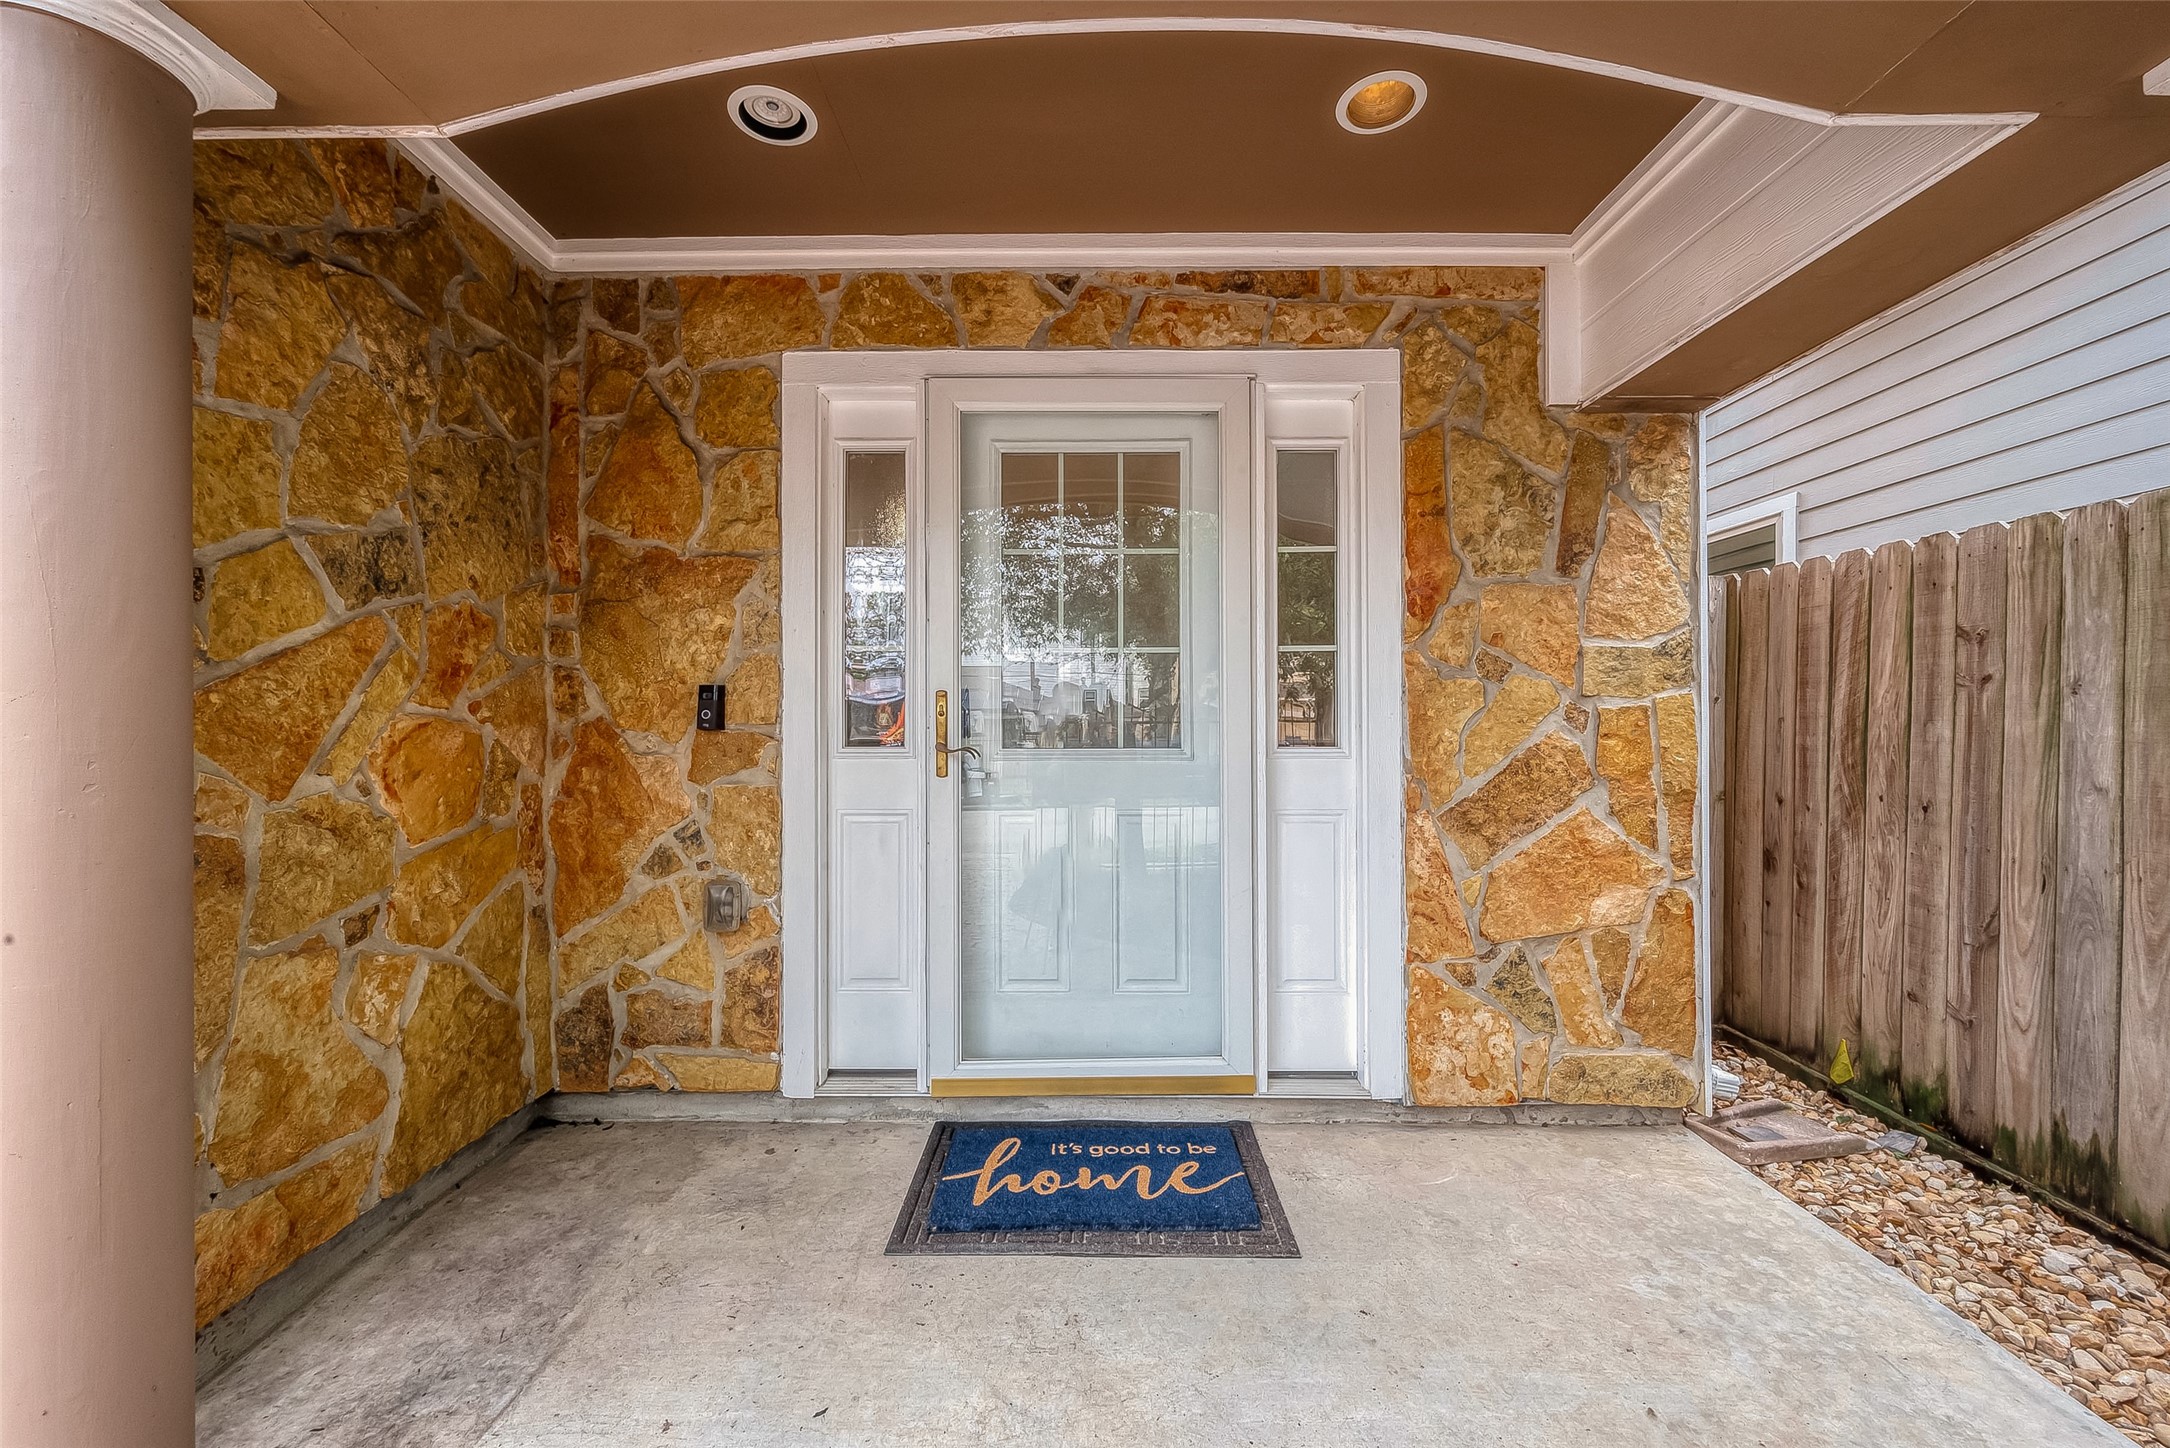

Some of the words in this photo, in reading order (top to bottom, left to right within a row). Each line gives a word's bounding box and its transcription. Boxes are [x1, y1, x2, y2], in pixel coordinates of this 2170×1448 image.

[1051, 1143, 1082, 1155] It's
[1089, 1143, 1150, 1157] good
[1157, 1143, 1181, 1154] to
[1187, 1143, 1217, 1154] be
[942, 1137, 1244, 1206] home
